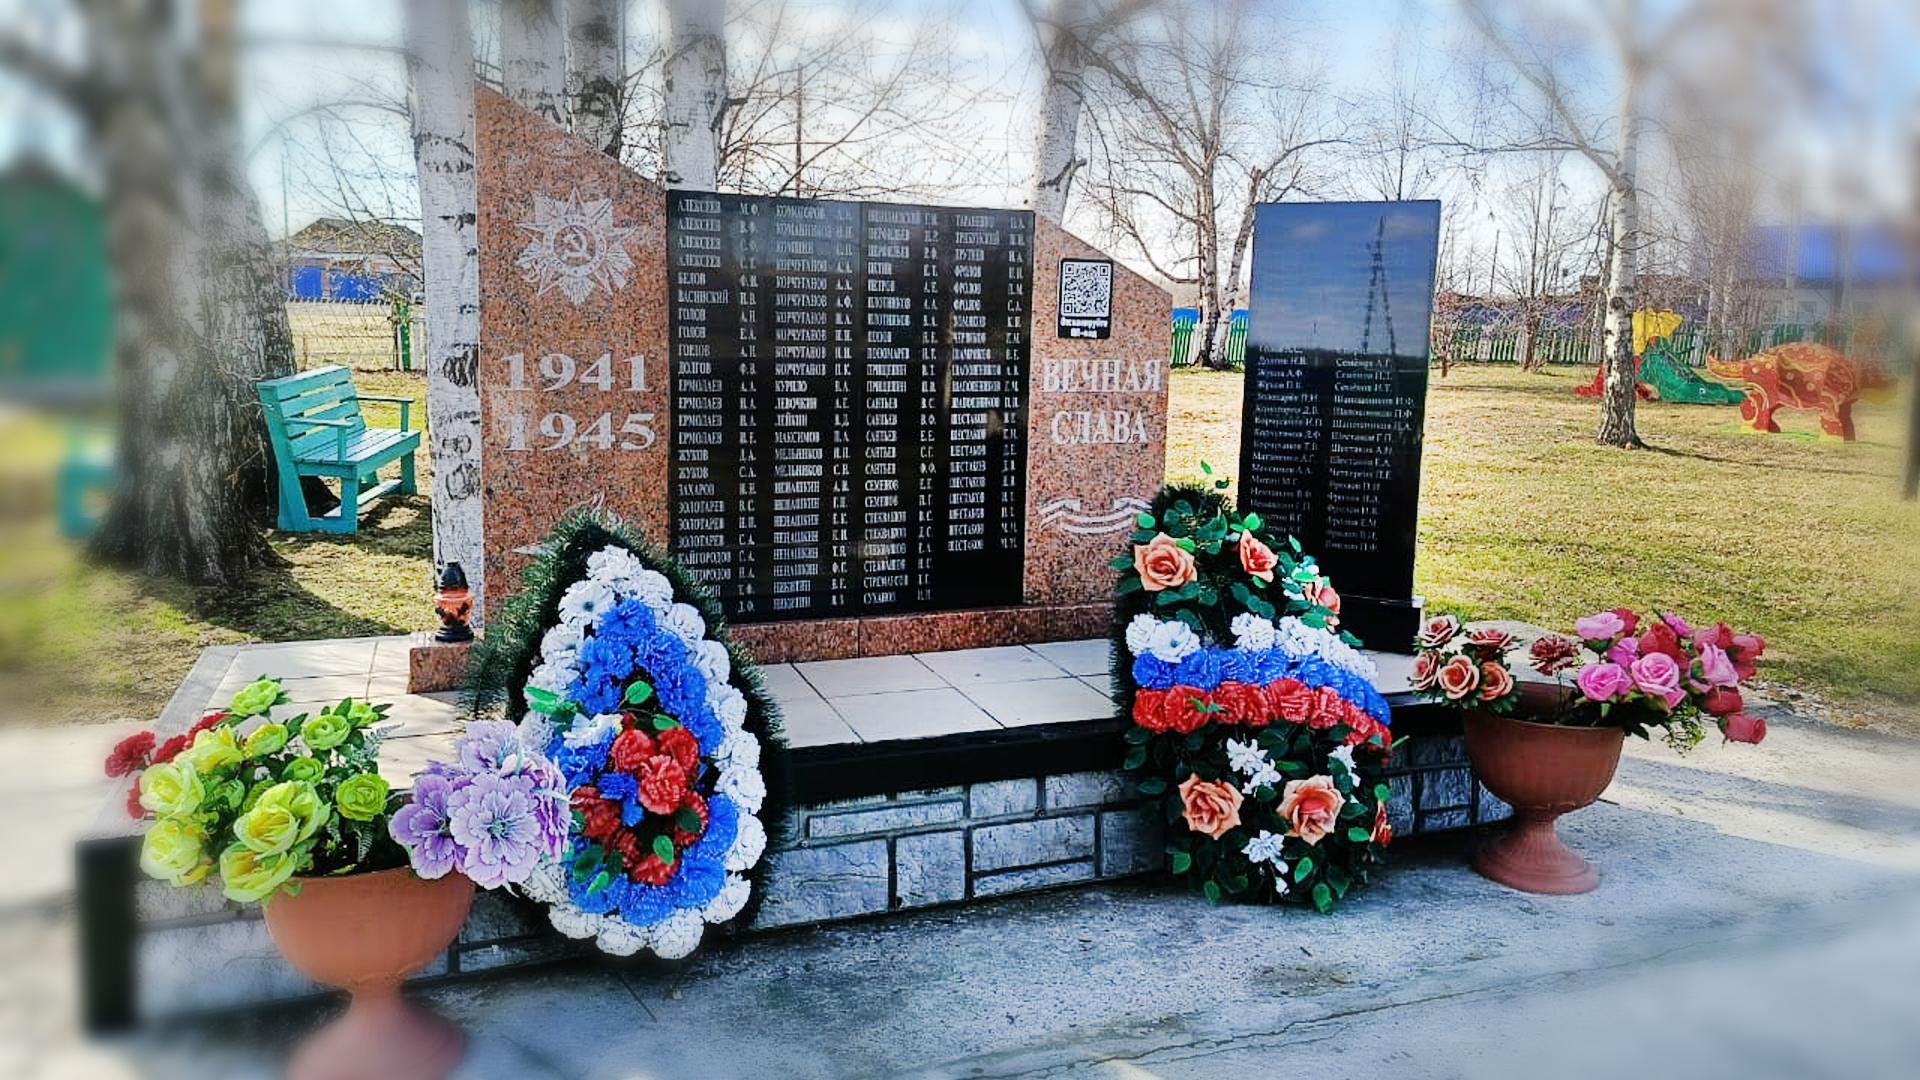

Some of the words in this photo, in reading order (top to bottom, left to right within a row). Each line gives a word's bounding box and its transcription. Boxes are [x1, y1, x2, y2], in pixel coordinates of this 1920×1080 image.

[500, 353, 655, 392] 1941
[1042, 359, 1162, 393] ВЕЧНАЯ
[500, 412, 656, 452] 1945
[1051, 411, 1149, 445] СЛАВА
